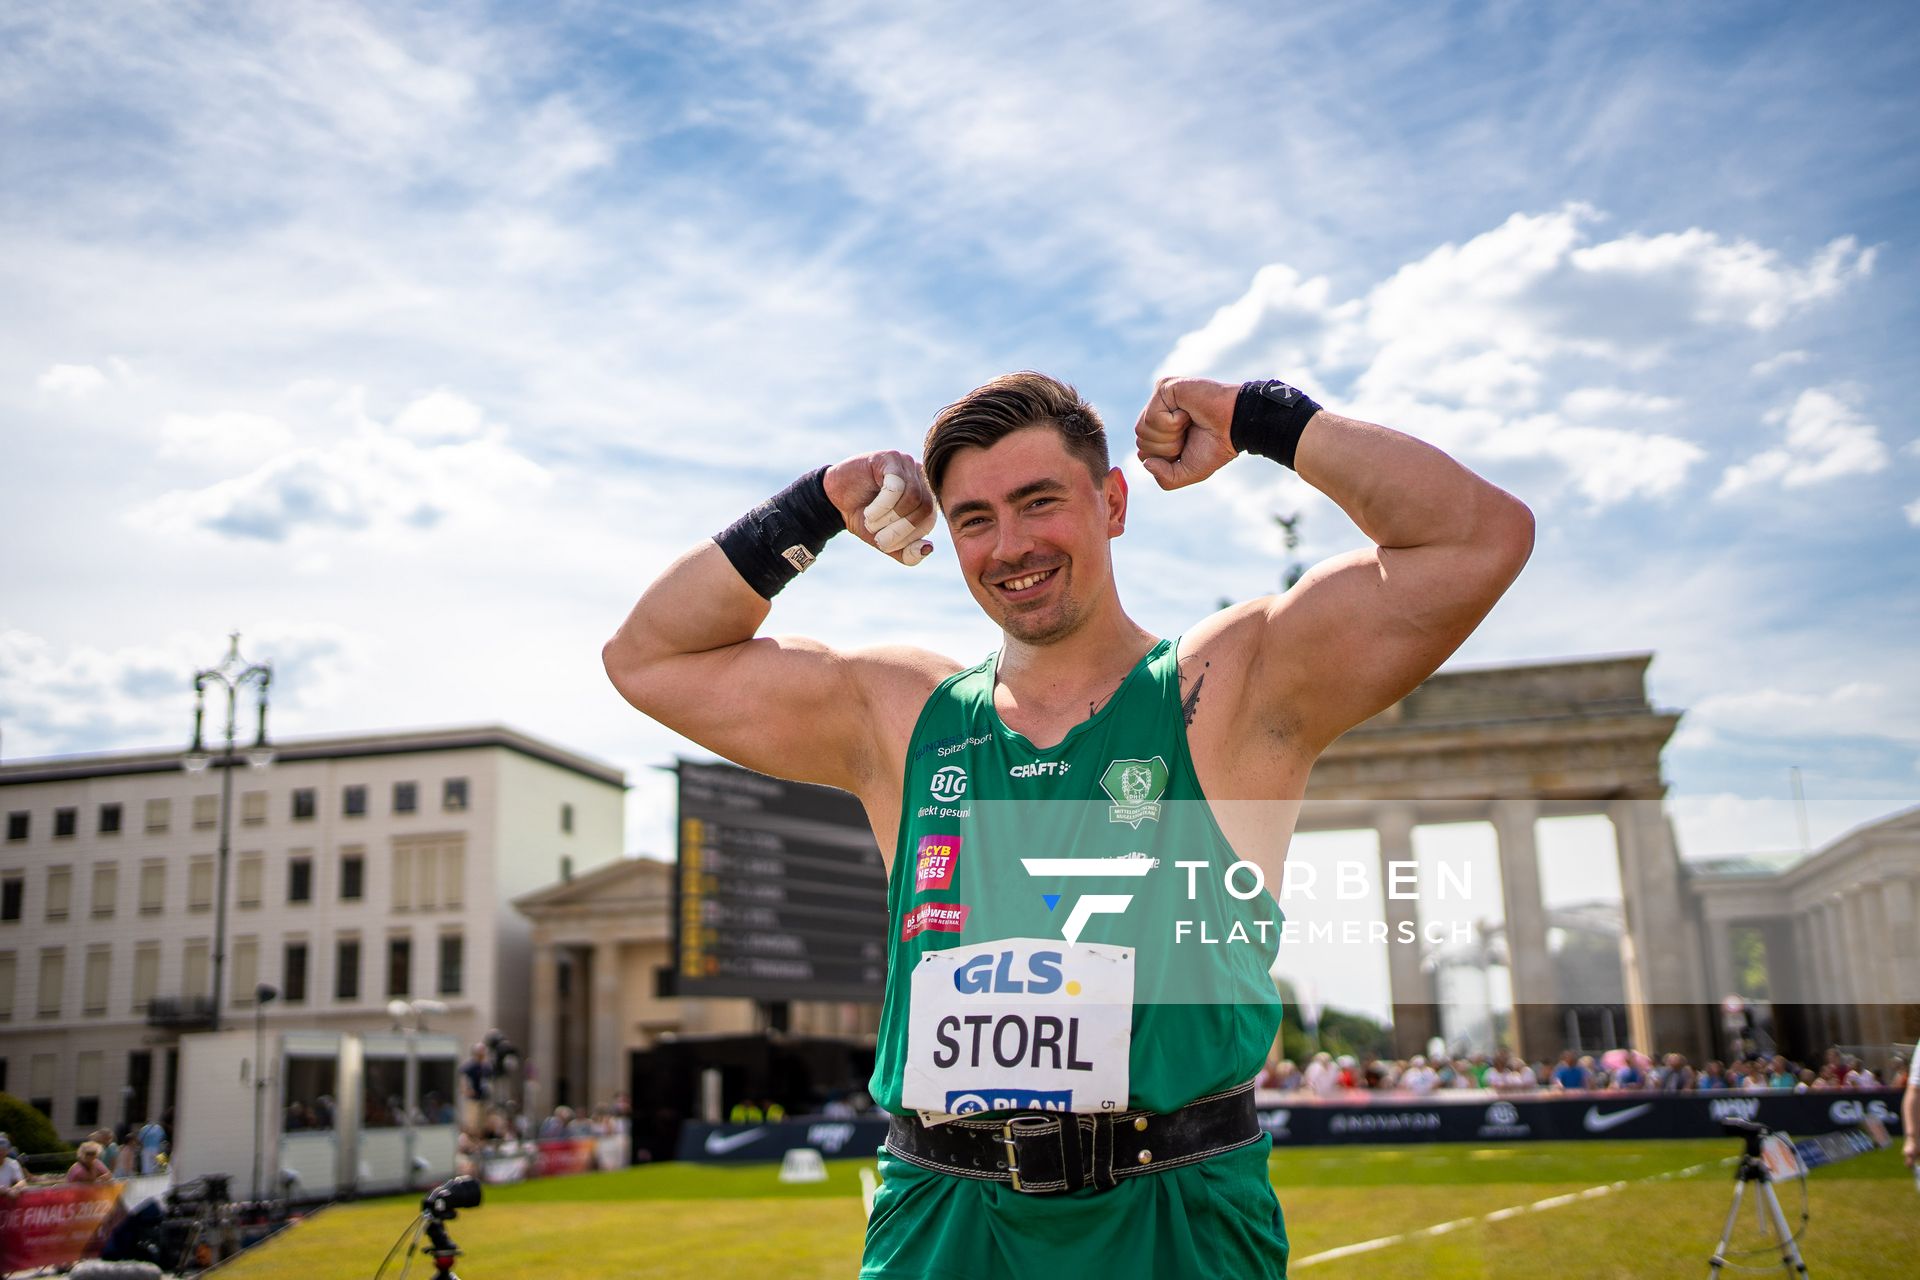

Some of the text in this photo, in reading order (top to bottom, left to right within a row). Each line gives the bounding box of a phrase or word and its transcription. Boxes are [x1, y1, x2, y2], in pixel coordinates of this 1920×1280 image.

[1009, 761, 1058, 778] CRAFT
[929, 773, 968, 794] BIG
[919, 856, 950, 869] ERFIT
[918, 867, 945, 880] NESS
[953, 950, 1082, 996] GLS.
[933, 1014, 1094, 1072] STORL
[22, 1202, 76, 1226] FINALS
